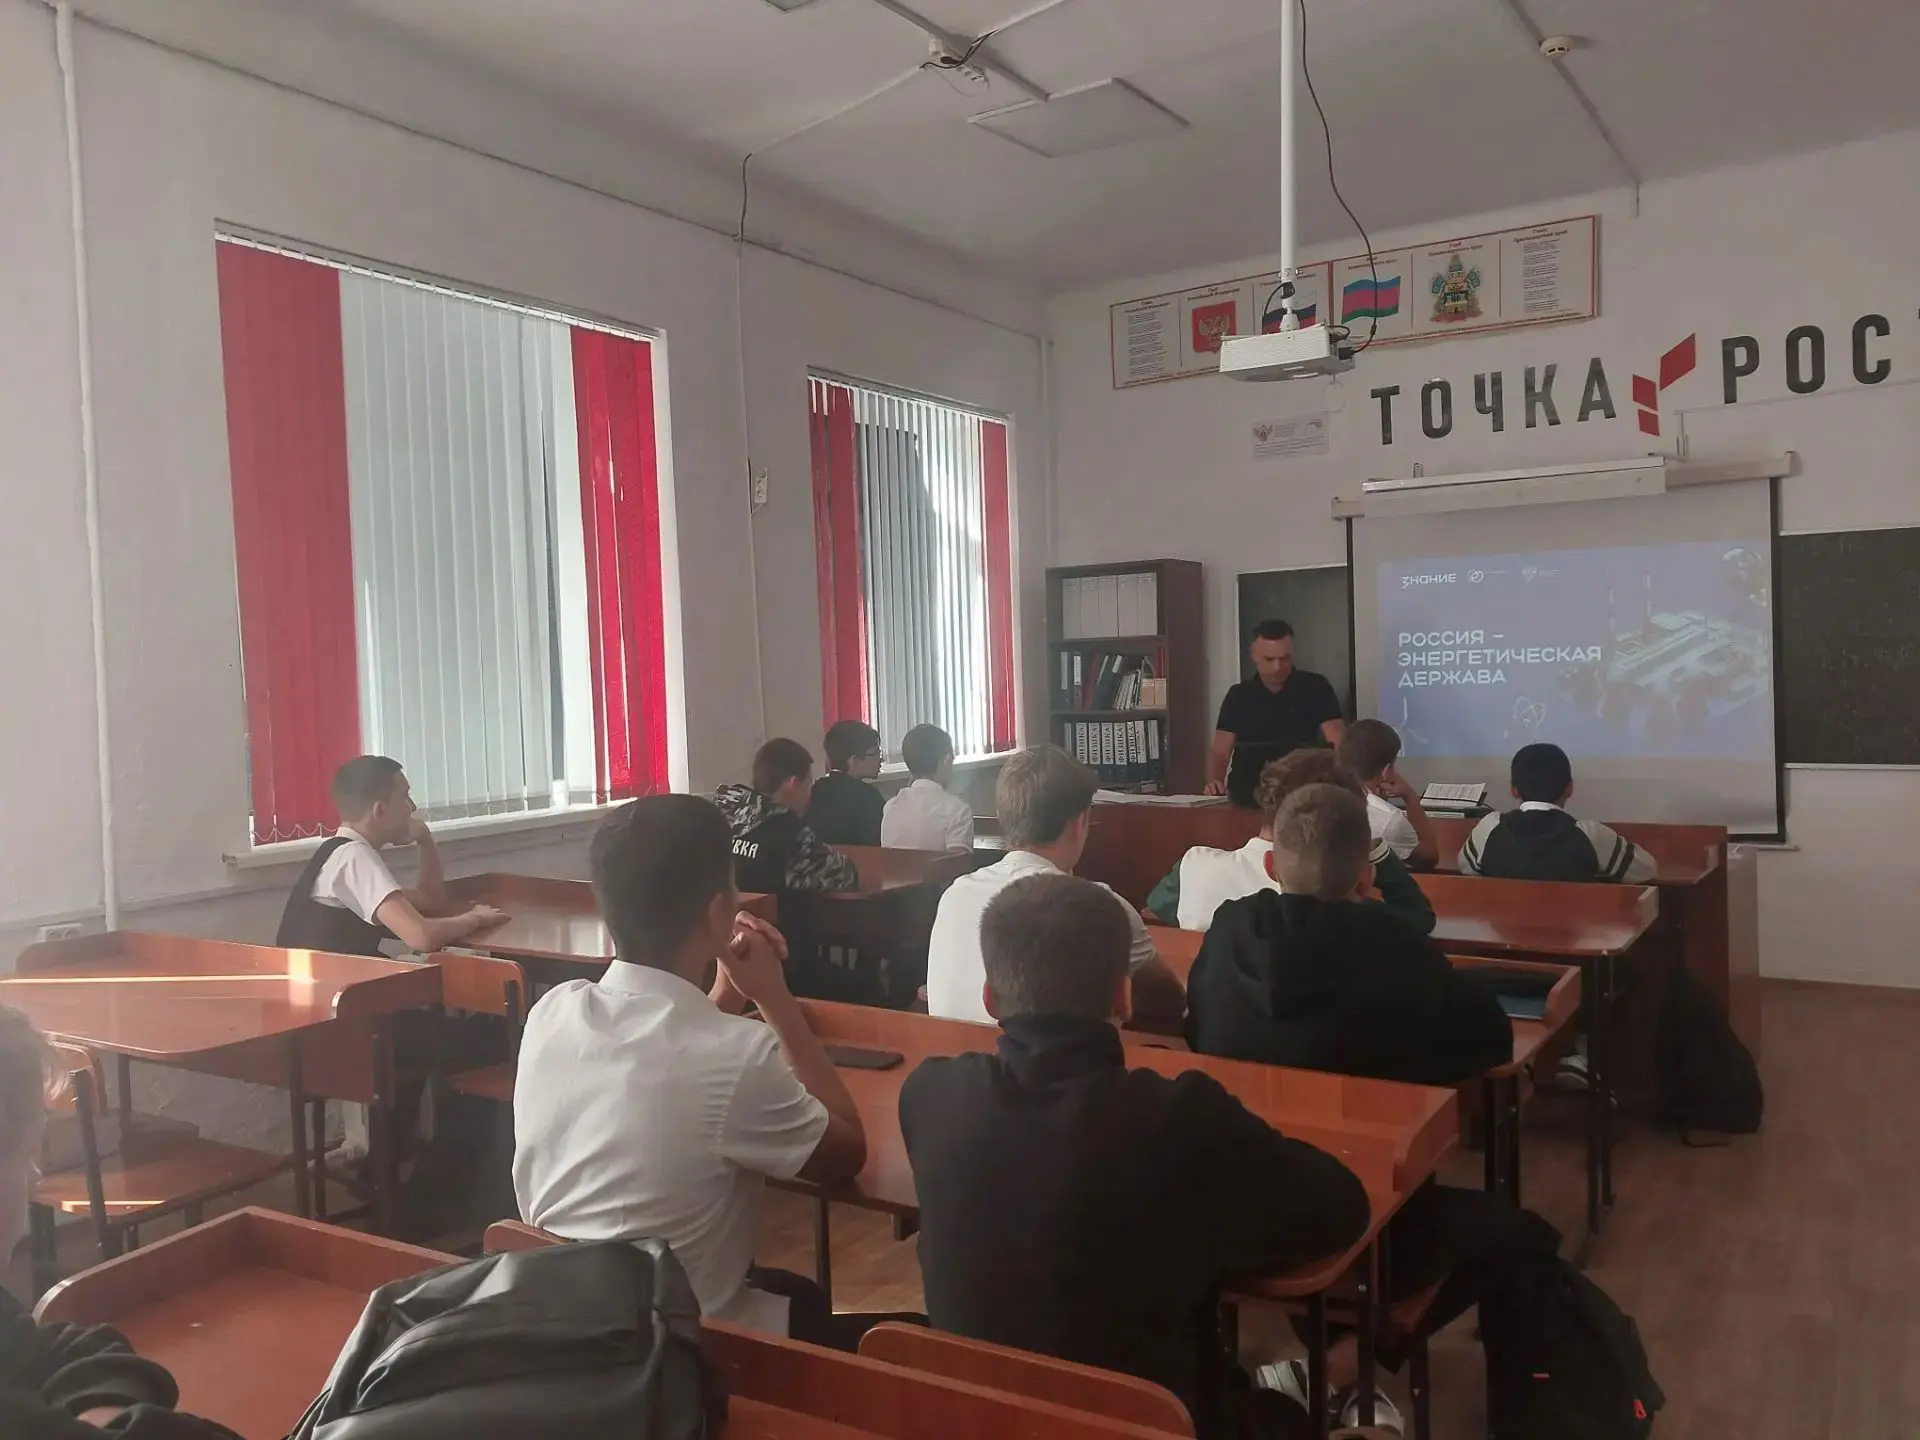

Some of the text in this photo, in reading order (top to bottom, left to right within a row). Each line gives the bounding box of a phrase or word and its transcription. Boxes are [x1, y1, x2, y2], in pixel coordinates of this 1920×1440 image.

[1370, 357, 1617, 445] ТОЧКА
[1721, 309, 1920, 404] РОС
[1399, 629, 1484, 647] РОССИЯ
[1398, 646, 1602, 666] ЭНЕРГЕТИЧЕСКАЯ
[1398, 668, 1506, 688] ДЕРЖАВА
